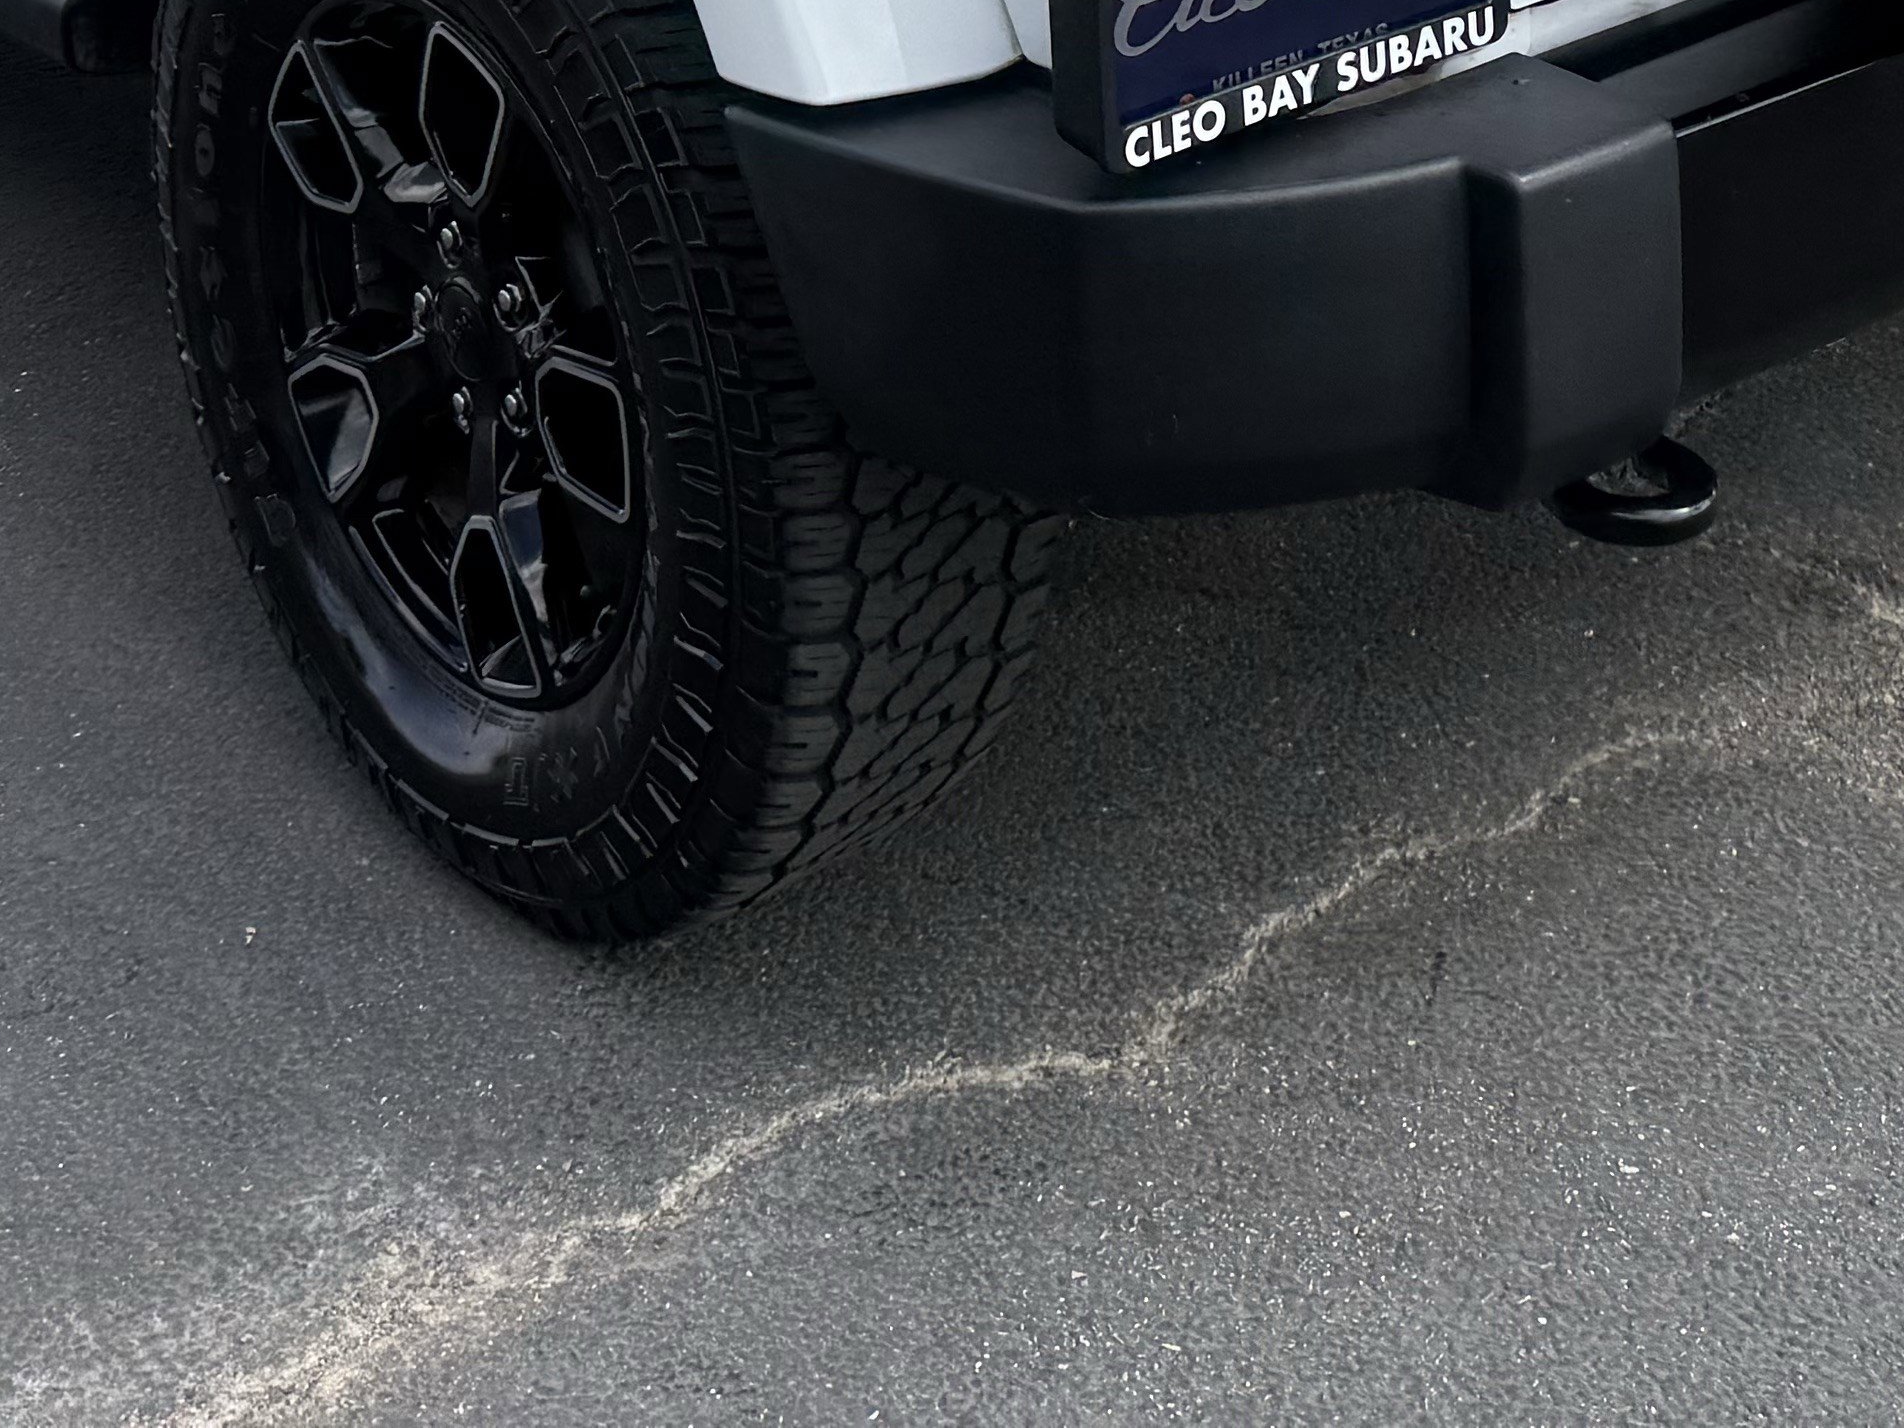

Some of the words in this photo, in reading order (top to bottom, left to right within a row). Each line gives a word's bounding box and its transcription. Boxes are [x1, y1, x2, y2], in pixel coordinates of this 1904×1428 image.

[1123, 95, 1227, 169] CLEO
[1241, 61, 1324, 130] BAY
[1336, 5, 1496, 94] SUBARU
